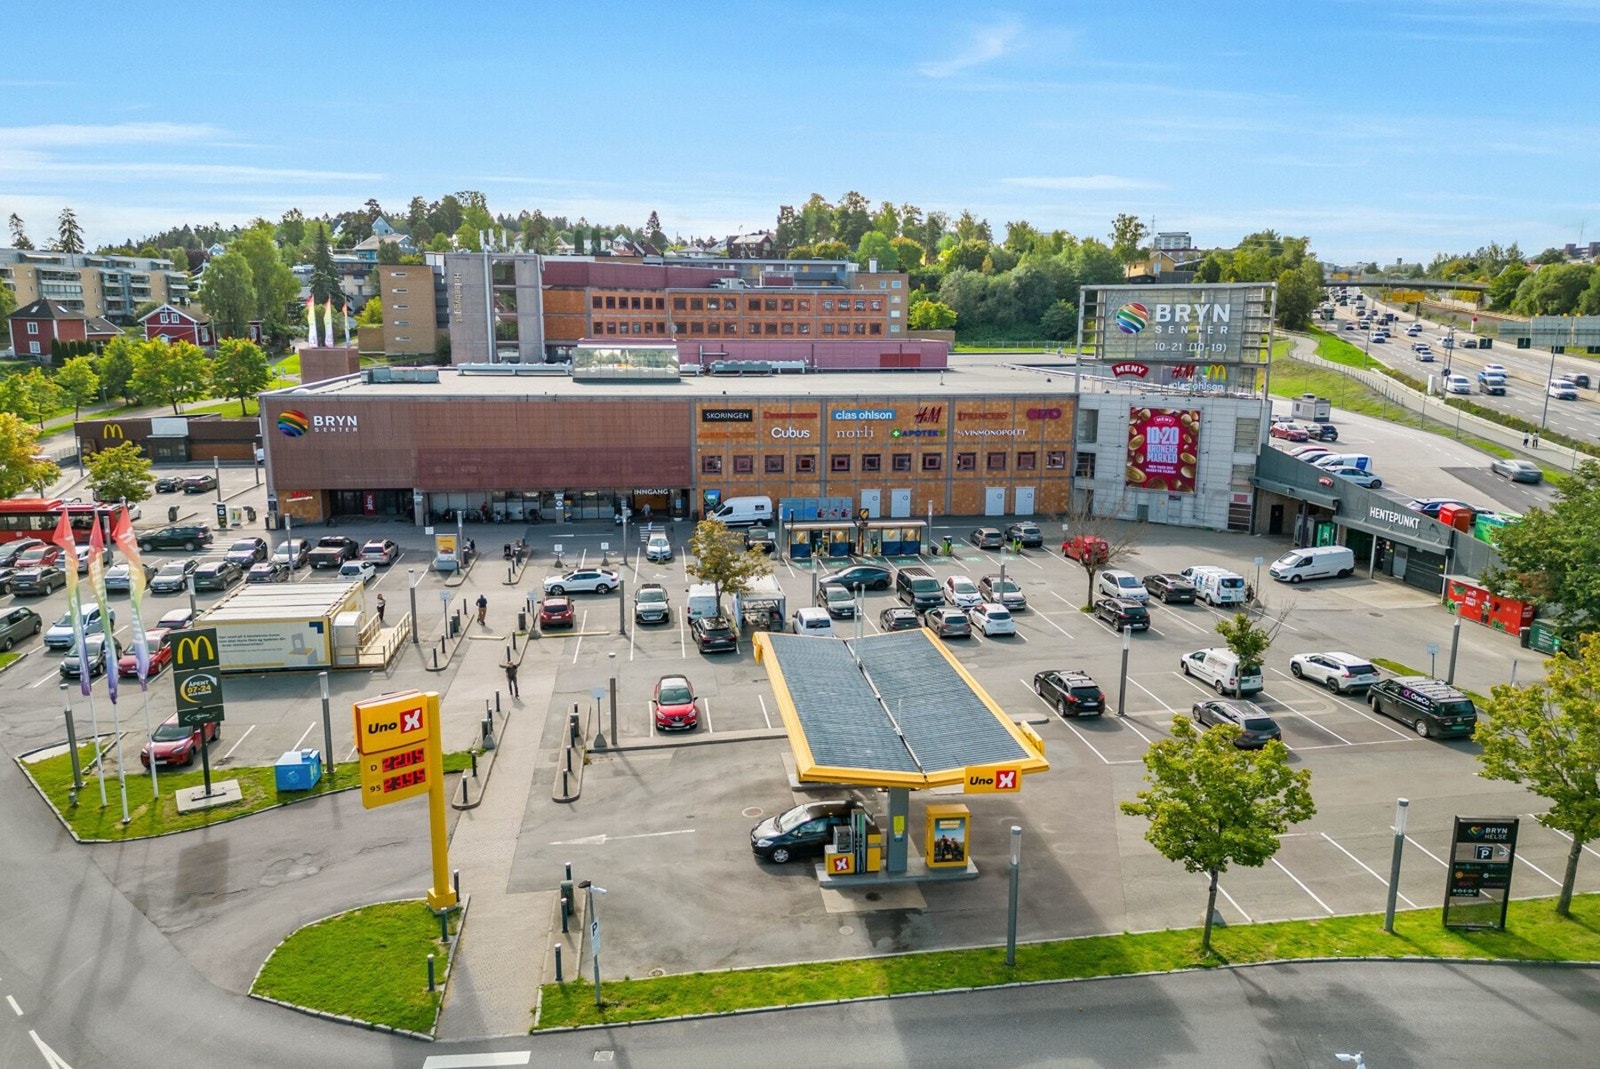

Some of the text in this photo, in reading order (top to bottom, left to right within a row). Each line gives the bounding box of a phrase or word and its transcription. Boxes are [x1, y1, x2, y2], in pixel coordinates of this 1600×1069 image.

[1155, 303, 1231, 322] BRYN
[1155, 325, 1228, 334] SENTER
[1155, 342, 1183, 351] 10-21
[1116, 365, 1145, 374] MENY
[1192, 382, 1223, 391] ohlson
[835, 410, 893, 420] clas ohlson
[914, 406, 942, 423] H&M
[313, 415, 358, 427] BRYN
[771, 427, 810, 438] Cubus
[836, 425, 874, 438] norli
[902, 429, 938, 437] APOTEK
[634, 488, 669, 496] INNGANG
[1370, 506, 1420, 529] HENTEPUNKT
[187, 685, 211, 693] 07-24
[1411, 692, 1430, 706] OneCo
[368, 709, 421, 734] Uno X
[969, 771, 1015, 788] Uno X
[1481, 849, 1490, 859] P
[592, 922, 598, 936] P
